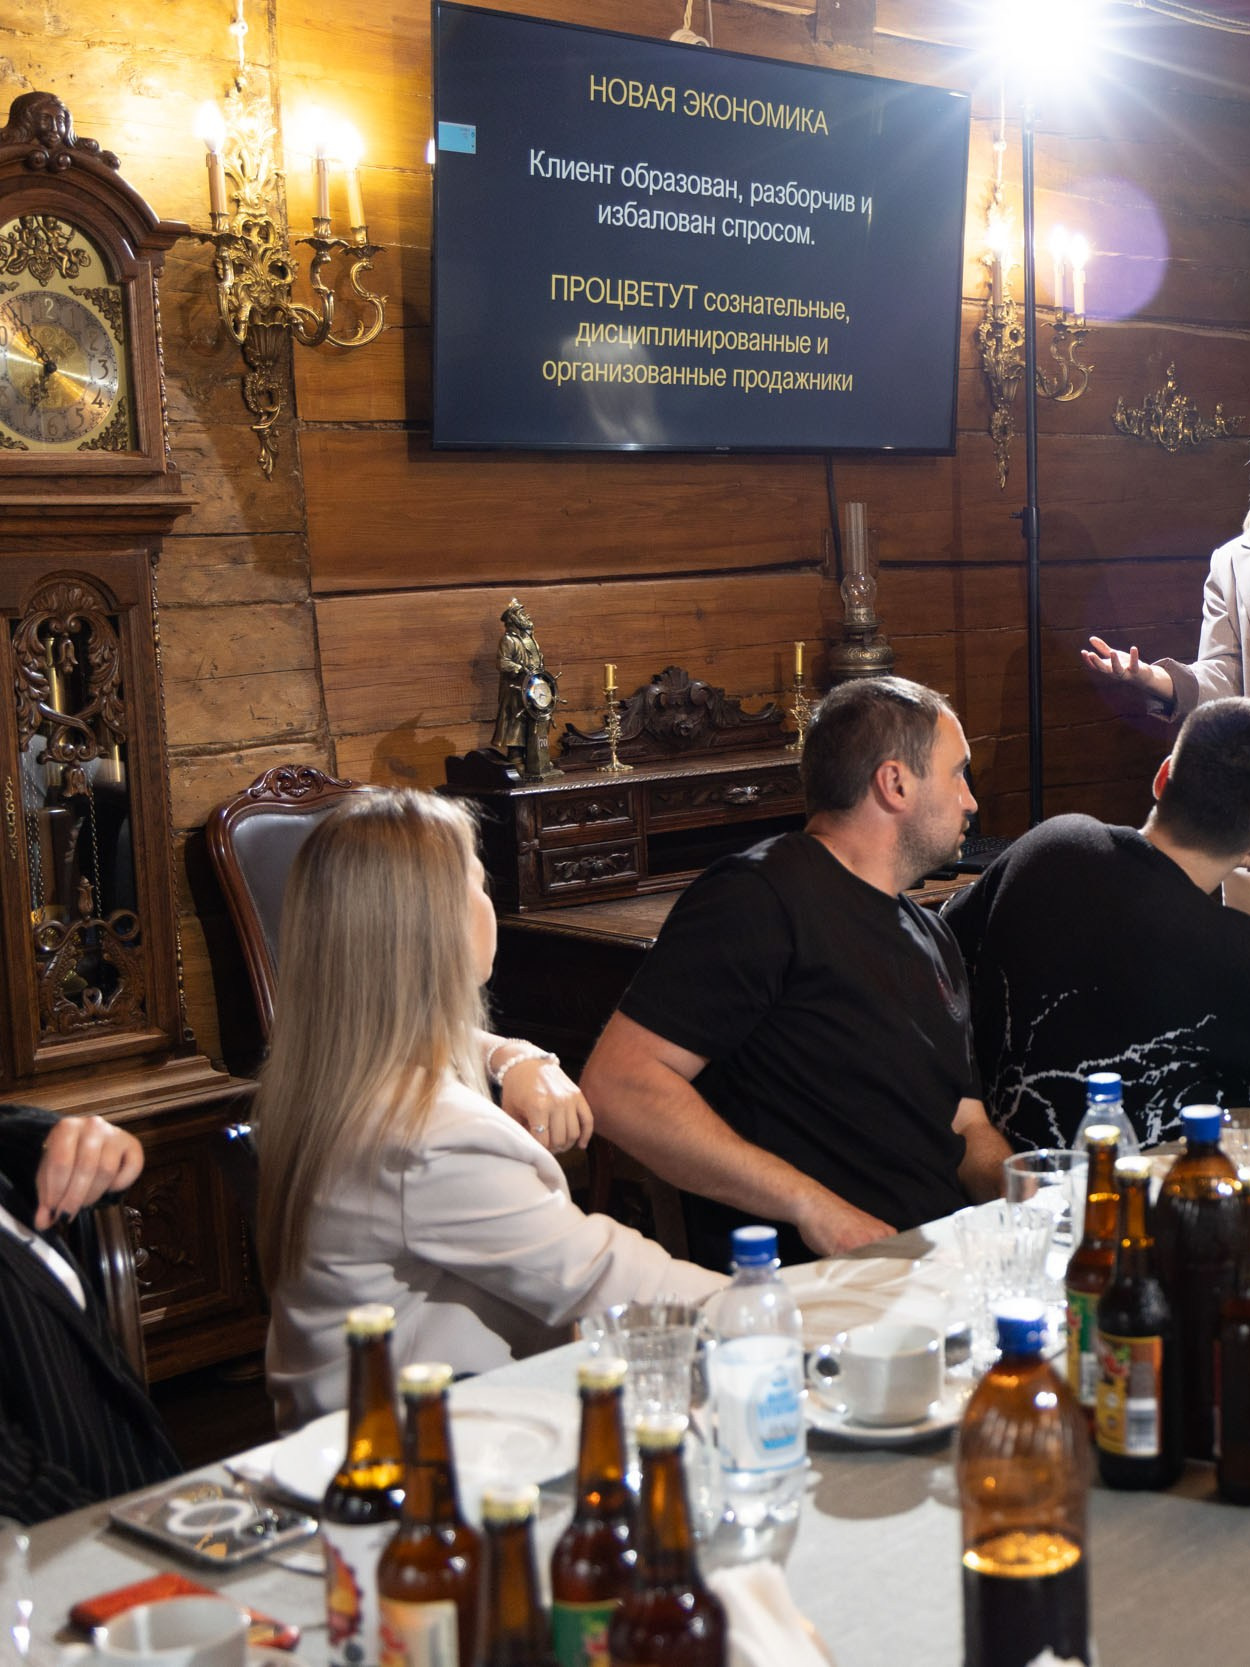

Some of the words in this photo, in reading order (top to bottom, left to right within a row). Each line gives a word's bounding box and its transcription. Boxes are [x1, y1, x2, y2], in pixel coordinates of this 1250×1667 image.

[590, 74, 676, 113] НОВАЯ
[683, 89, 829, 135] ЭКОНОМИКА
[530, 149, 614, 184] Клиент
[621, 163, 743, 203] образован,
[750, 182, 855, 213] разборчив
[861, 196, 872, 214] и
[598, 201, 716, 235] избалован
[722, 217, 815, 245] спросом.
[551, 274, 698, 312] ПРОЦВЕТУТ
[704, 292, 850, 324] сознательные,
[575, 322, 811, 354] дисциплинированные
[817, 337, 829, 355] и
[97, 358, 109, 380] 3
[542, 360, 727, 387] организованные
[733, 368, 853, 394] продажники
[91, 387, 105, 408] 4
[47, 415, 58, 437] 6
[75, 407, 84, 430] 5
